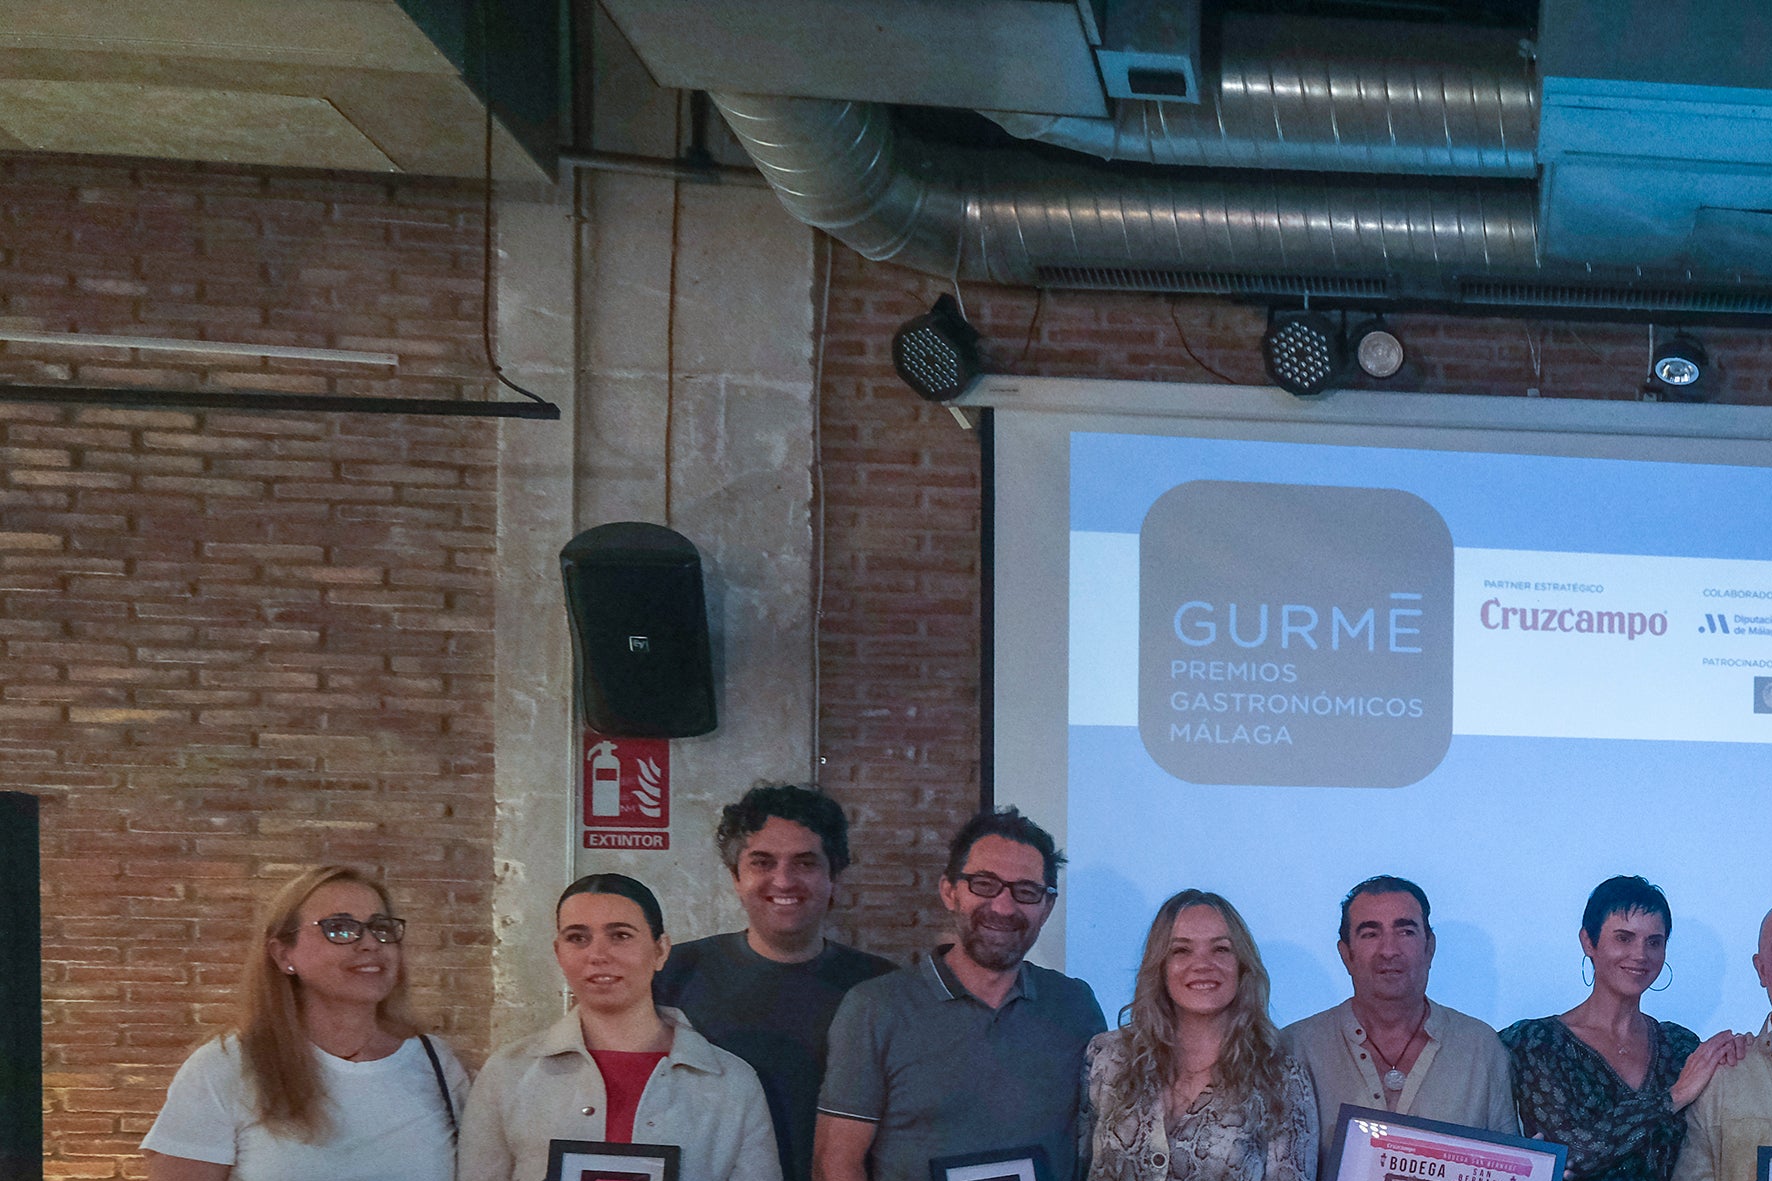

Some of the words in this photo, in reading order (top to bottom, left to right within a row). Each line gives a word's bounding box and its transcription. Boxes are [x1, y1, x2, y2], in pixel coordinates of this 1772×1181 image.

[1484, 579, 1531, 590] PARTNER
[1534, 582, 1605, 593] ESTRATÉGICO
[1480, 597, 1668, 640] Cruzcampo
[1734, 626, 1746, 635] de
[1171, 660, 1298, 683] PREMIOS
[1170, 691, 1424, 719] GASTRONÓMICOS
[1169, 719, 1293, 746] MÁLAGA
[589, 834, 663, 848] EXTINTOR
[1389, 1156, 1446, 1178] BODEGA
[1473, 1168, 1492, 1178] SAN
